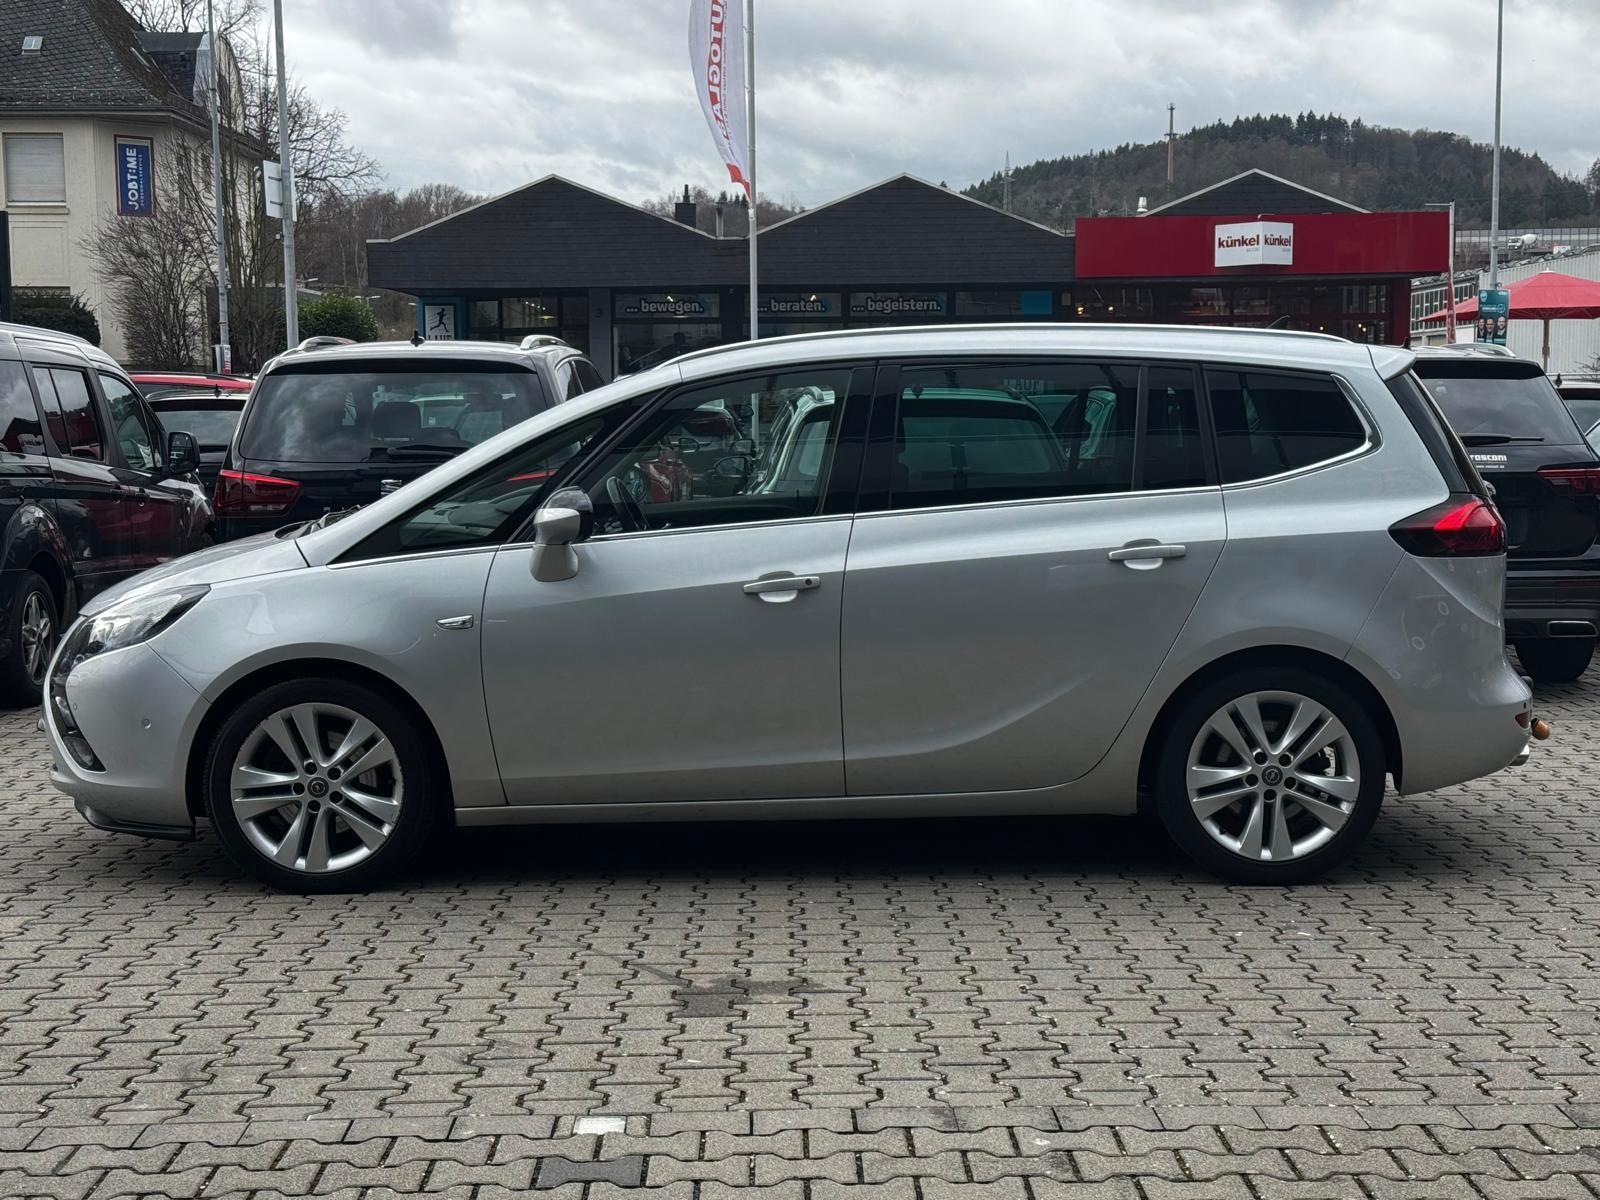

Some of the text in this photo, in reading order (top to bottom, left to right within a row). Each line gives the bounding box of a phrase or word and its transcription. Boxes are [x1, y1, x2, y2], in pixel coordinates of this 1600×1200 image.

[1218, 234, 1260, 248] künkel
[1264, 234, 1292, 247] künkel
[641, 300, 703, 314] bewegen.
[771, 299, 825, 311] beraten.
[868, 298, 941, 313] begeistern.
